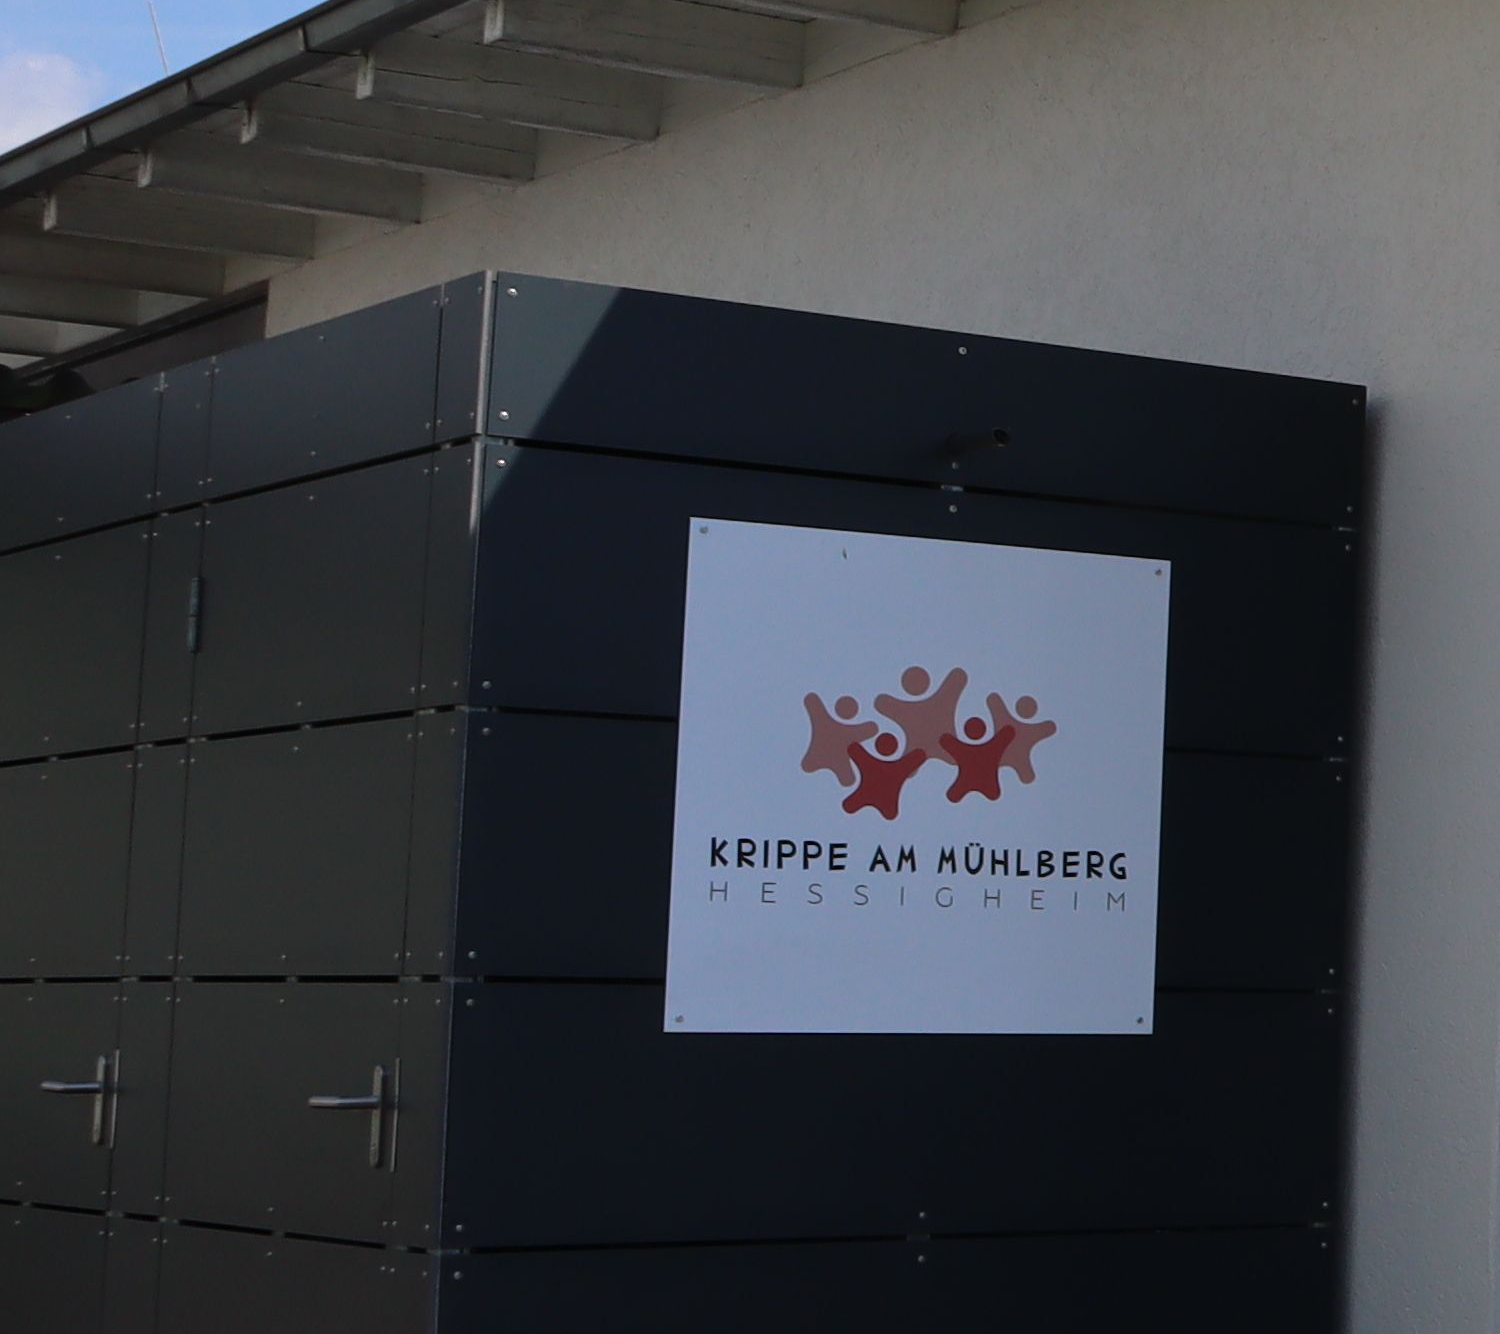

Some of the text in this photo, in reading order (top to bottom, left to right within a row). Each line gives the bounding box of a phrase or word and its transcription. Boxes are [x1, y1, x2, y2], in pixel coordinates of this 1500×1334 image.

[710, 836, 1127, 880] KRIPPE AM MÜHLBERG
[709, 880, 1126, 912] HESSIGHEIM
